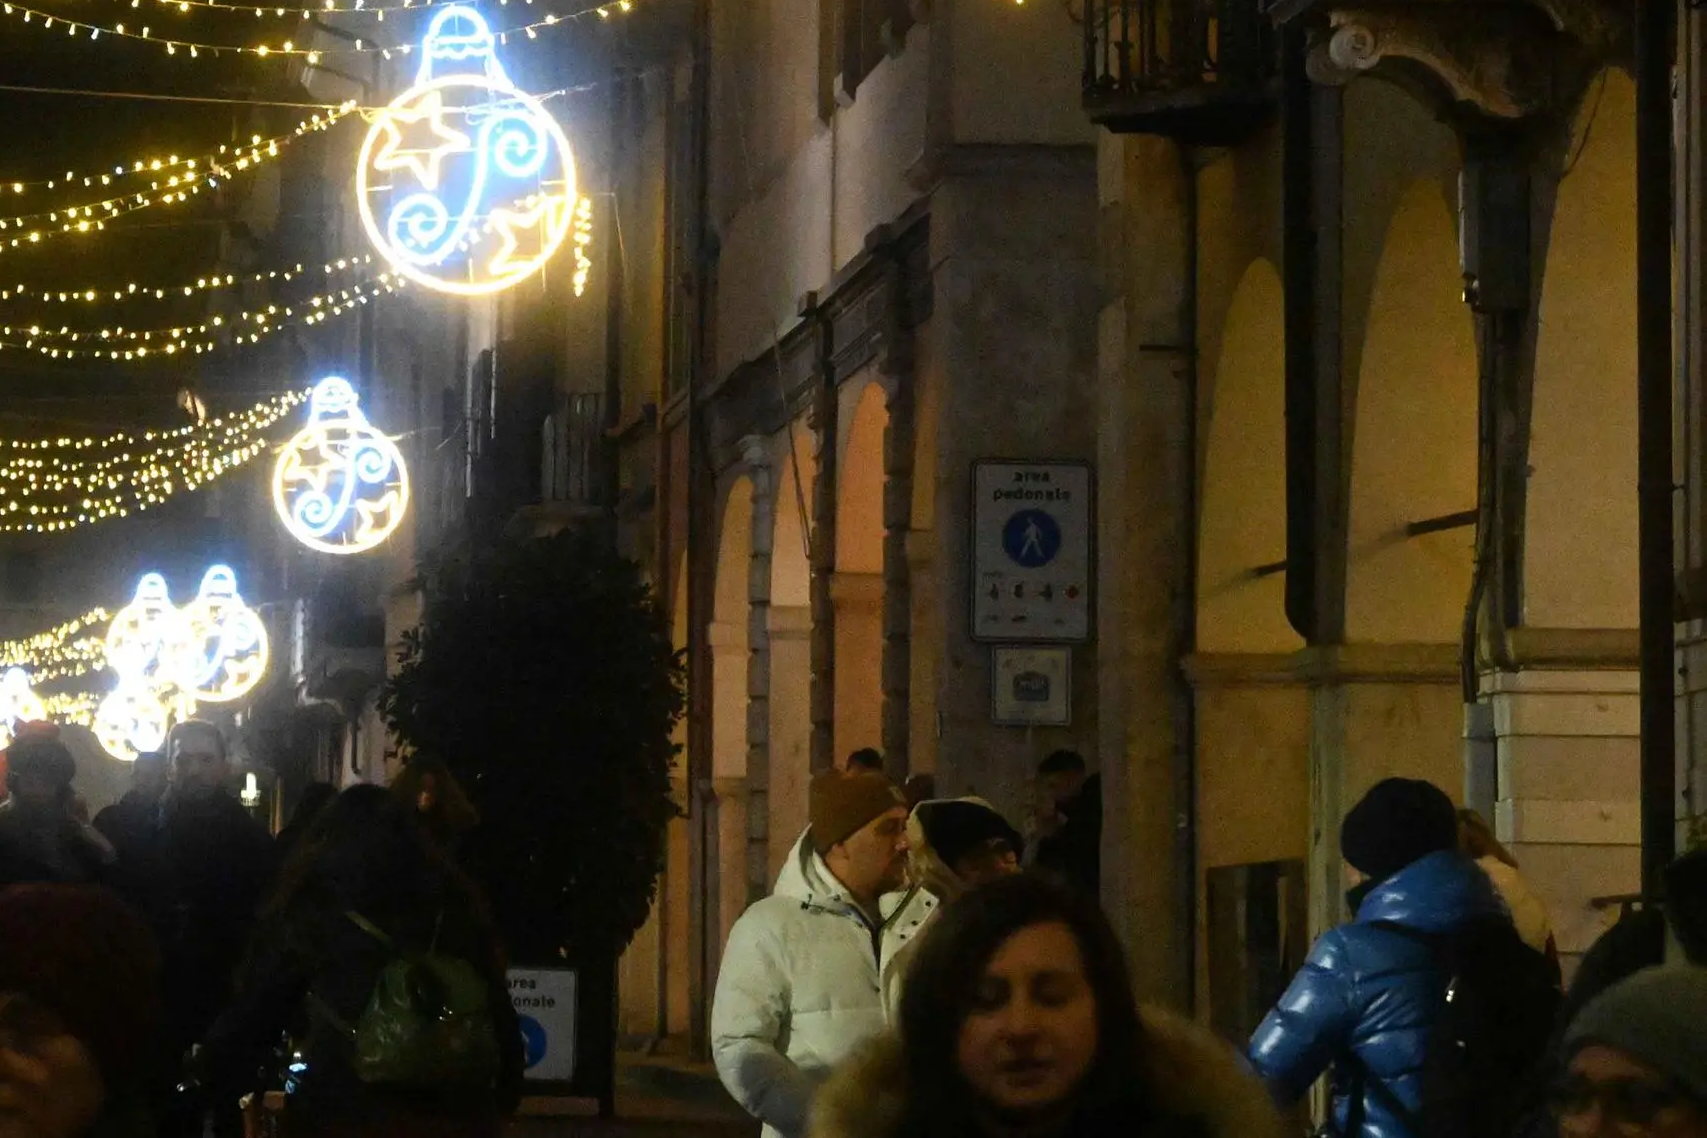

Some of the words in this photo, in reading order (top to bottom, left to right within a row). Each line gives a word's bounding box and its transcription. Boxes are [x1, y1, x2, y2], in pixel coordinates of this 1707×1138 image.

[1013, 471, 1050, 482] area
[993, 487, 1070, 502] pedonale
[513, 994, 555, 1008] onale
